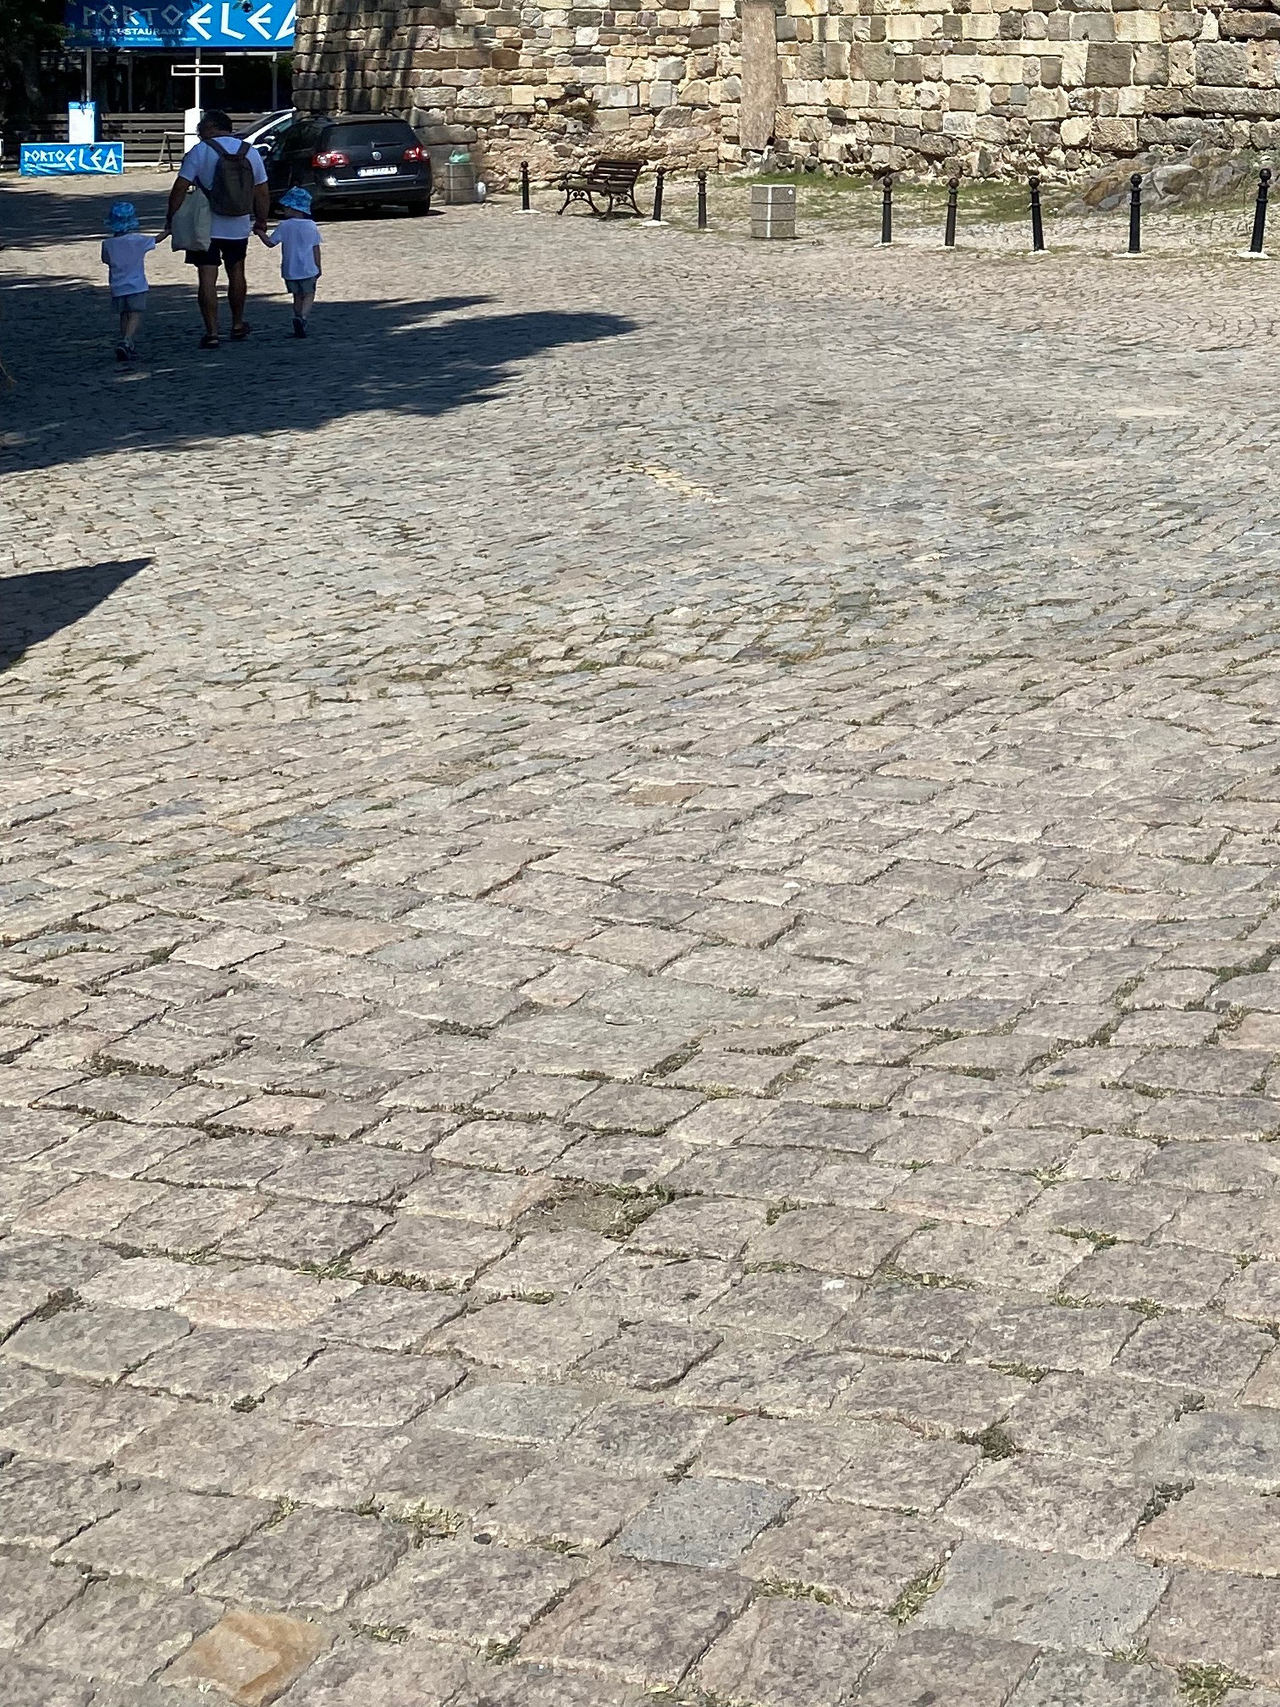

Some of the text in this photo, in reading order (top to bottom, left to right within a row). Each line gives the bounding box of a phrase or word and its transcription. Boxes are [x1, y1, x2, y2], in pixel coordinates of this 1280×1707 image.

[82, 3, 184, 26] PORTO
[24, 148, 119, 171] PORTO ELEA
